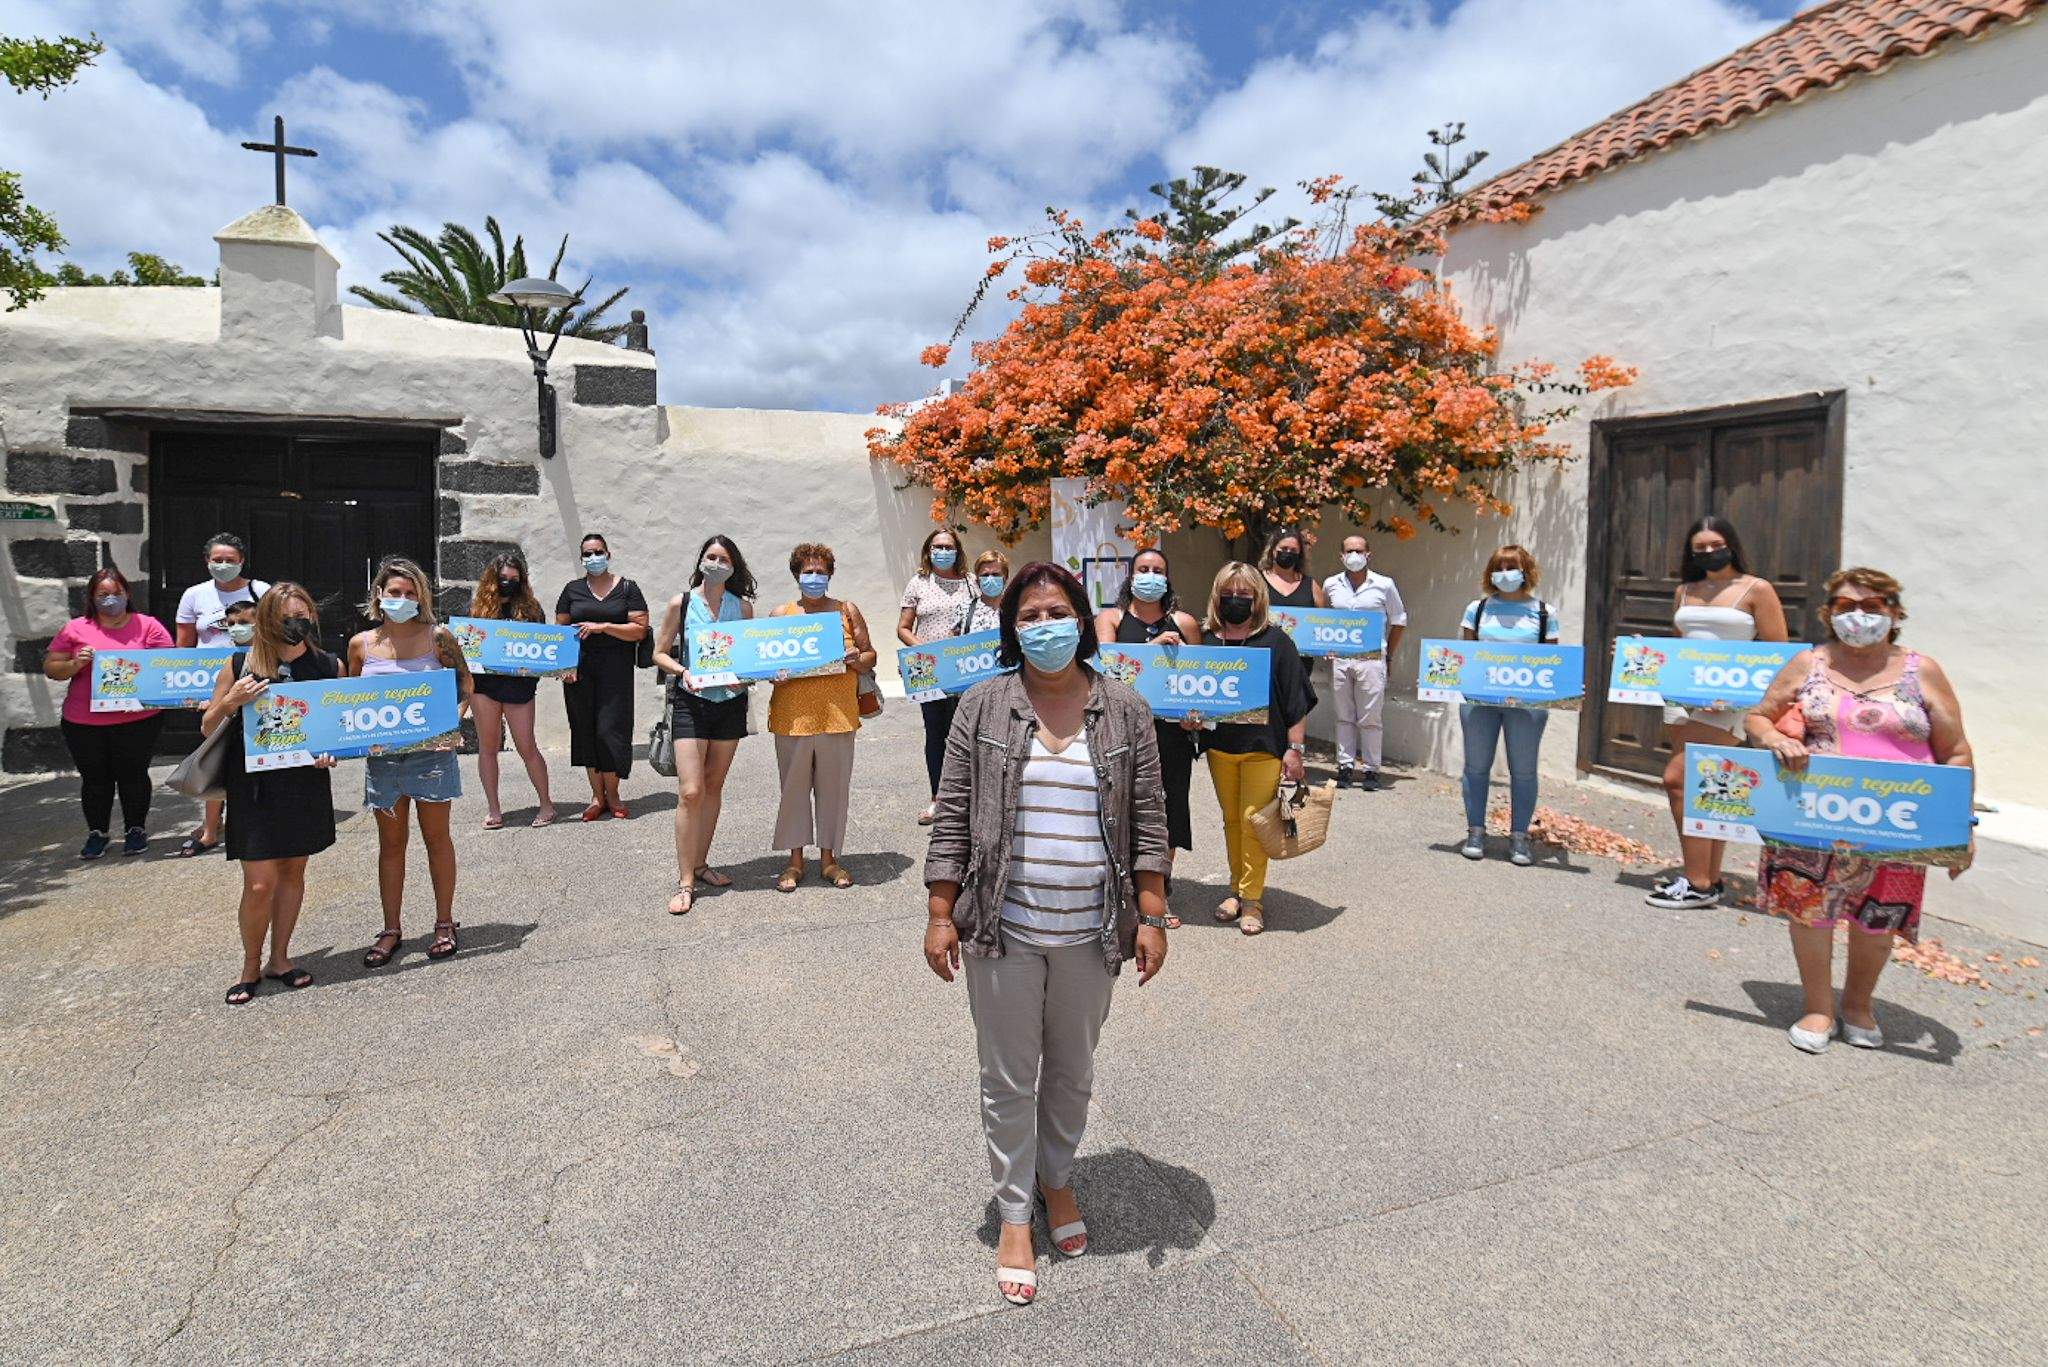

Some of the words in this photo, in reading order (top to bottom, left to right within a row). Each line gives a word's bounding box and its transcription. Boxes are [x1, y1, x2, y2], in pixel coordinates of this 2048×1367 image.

[743, 626, 784, 640] Cheque
[789, 621, 823, 639] regalo
[1152, 655, 1201, 672] Cheque
[1204, 658, 1249, 676] regalo
[1474, 650, 1517, 666] Cheque
[1522, 654, 1562, 668] regalo
[1679, 647, 1730, 664] Cheque
[1735, 652, 1784, 667] regalo
[321, 689, 381, 708] Cheque
[384, 681, 433, 702] regalo
[1861, 776, 1933, 798] regalo
